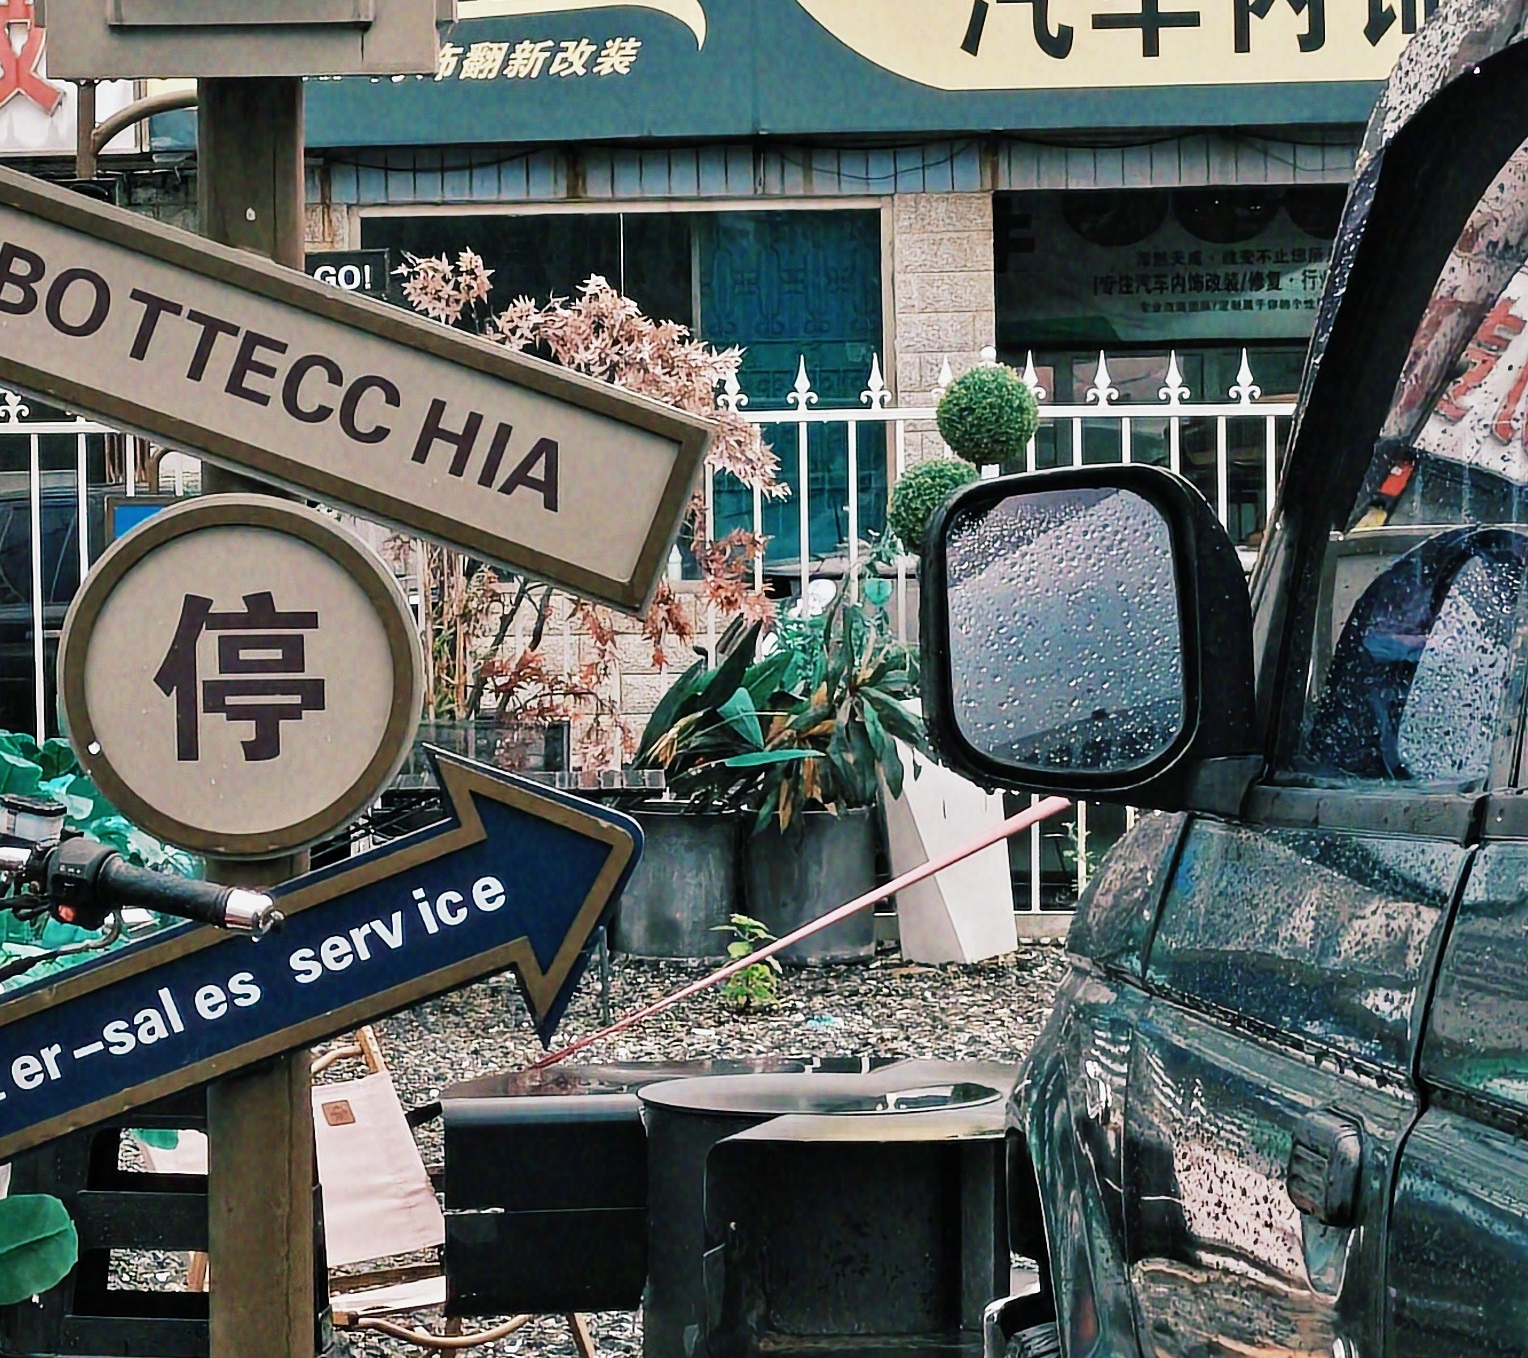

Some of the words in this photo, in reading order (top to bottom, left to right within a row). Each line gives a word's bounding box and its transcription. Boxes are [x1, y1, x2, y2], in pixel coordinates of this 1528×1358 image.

[313, 264, 371, 290] GO!
[153, 591, 325, 762] 停
[289, 869, 508, 983] service
